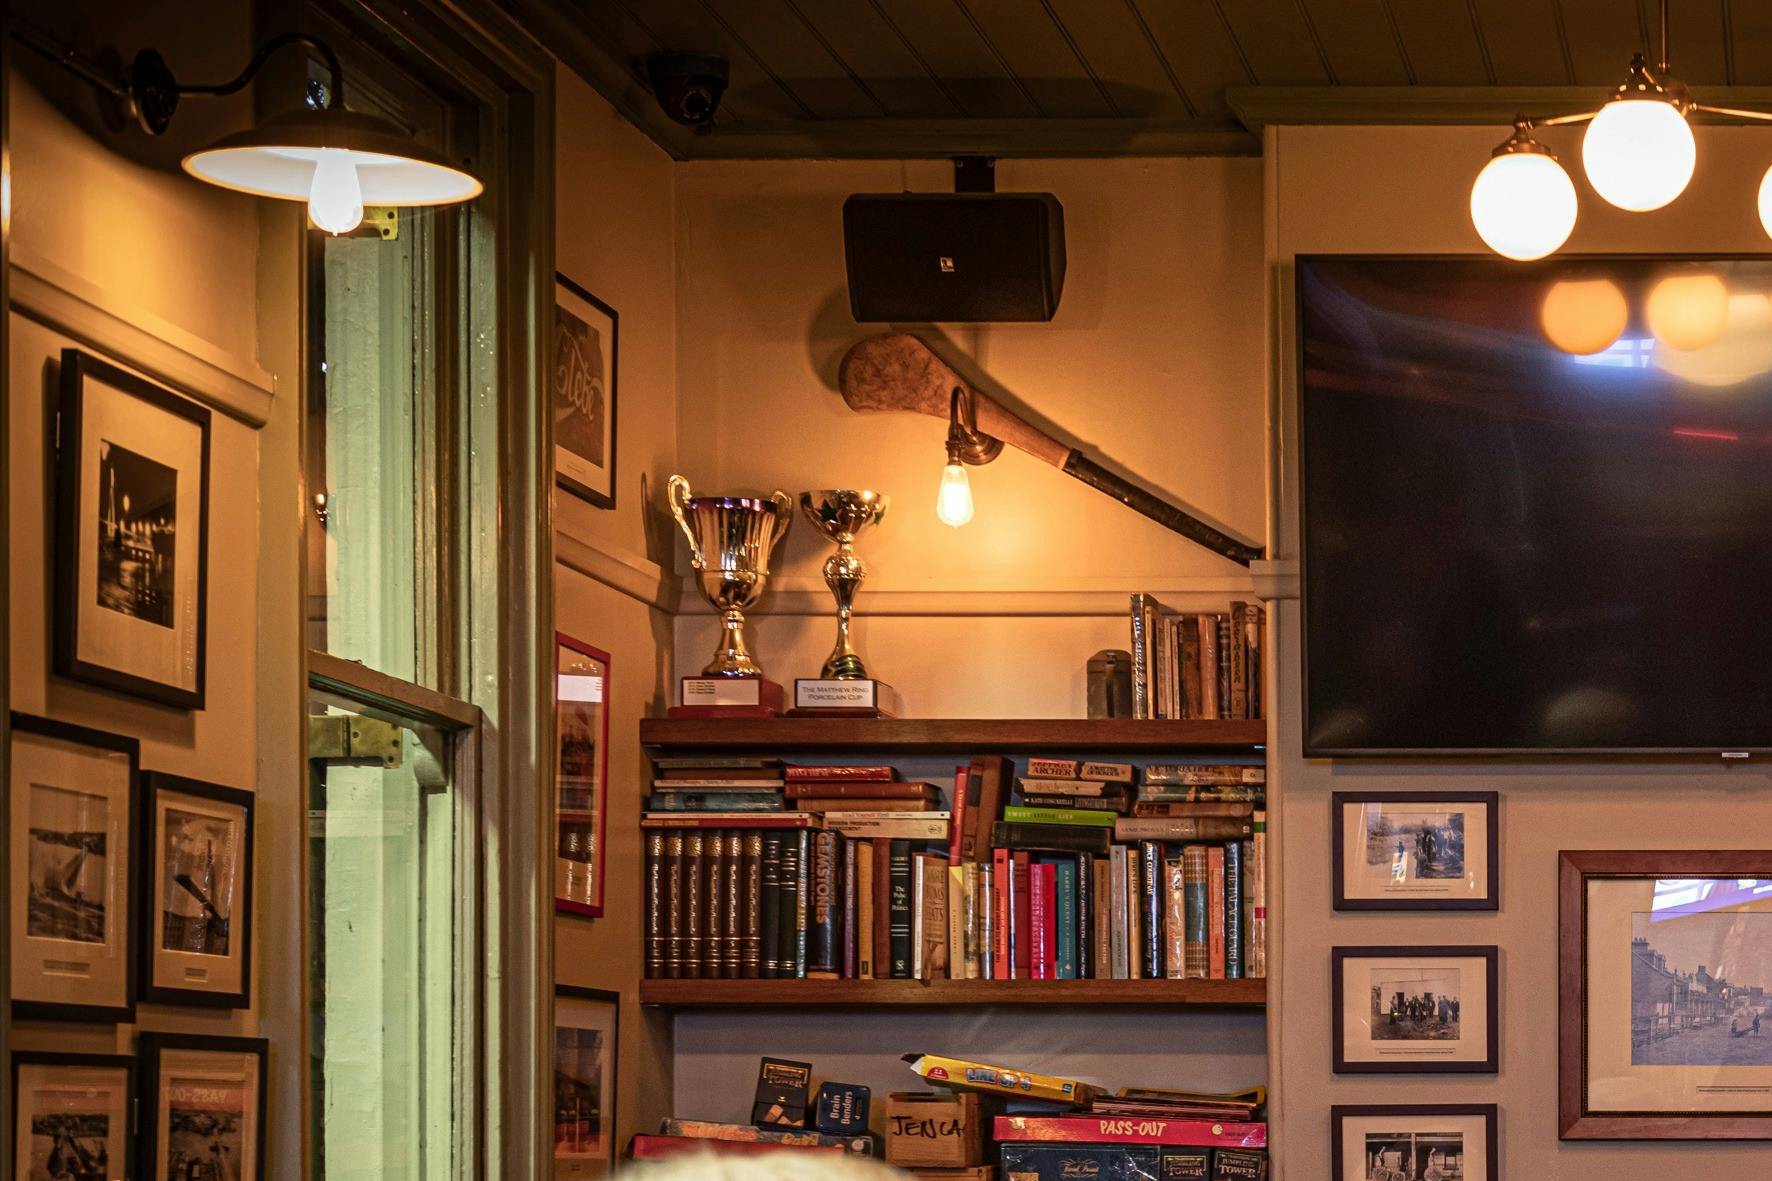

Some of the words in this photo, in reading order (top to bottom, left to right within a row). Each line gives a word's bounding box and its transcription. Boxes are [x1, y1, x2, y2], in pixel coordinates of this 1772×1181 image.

[1032, 768, 1071, 776] ARCHER
[816, 832, 830, 924] GEMSTONES
[1228, 928, 1238, 964] GUARD
[967, 1068, 997, 1083] LINE
[830, 1095, 841, 1119] Brain
[840, 1091, 853, 1125] Benders
[1100, 1120, 1167, 1137] PASS-OUT
[1168, 1167, 1204, 1176] TOWER
[1219, 1166, 1255, 1178] TOWER
